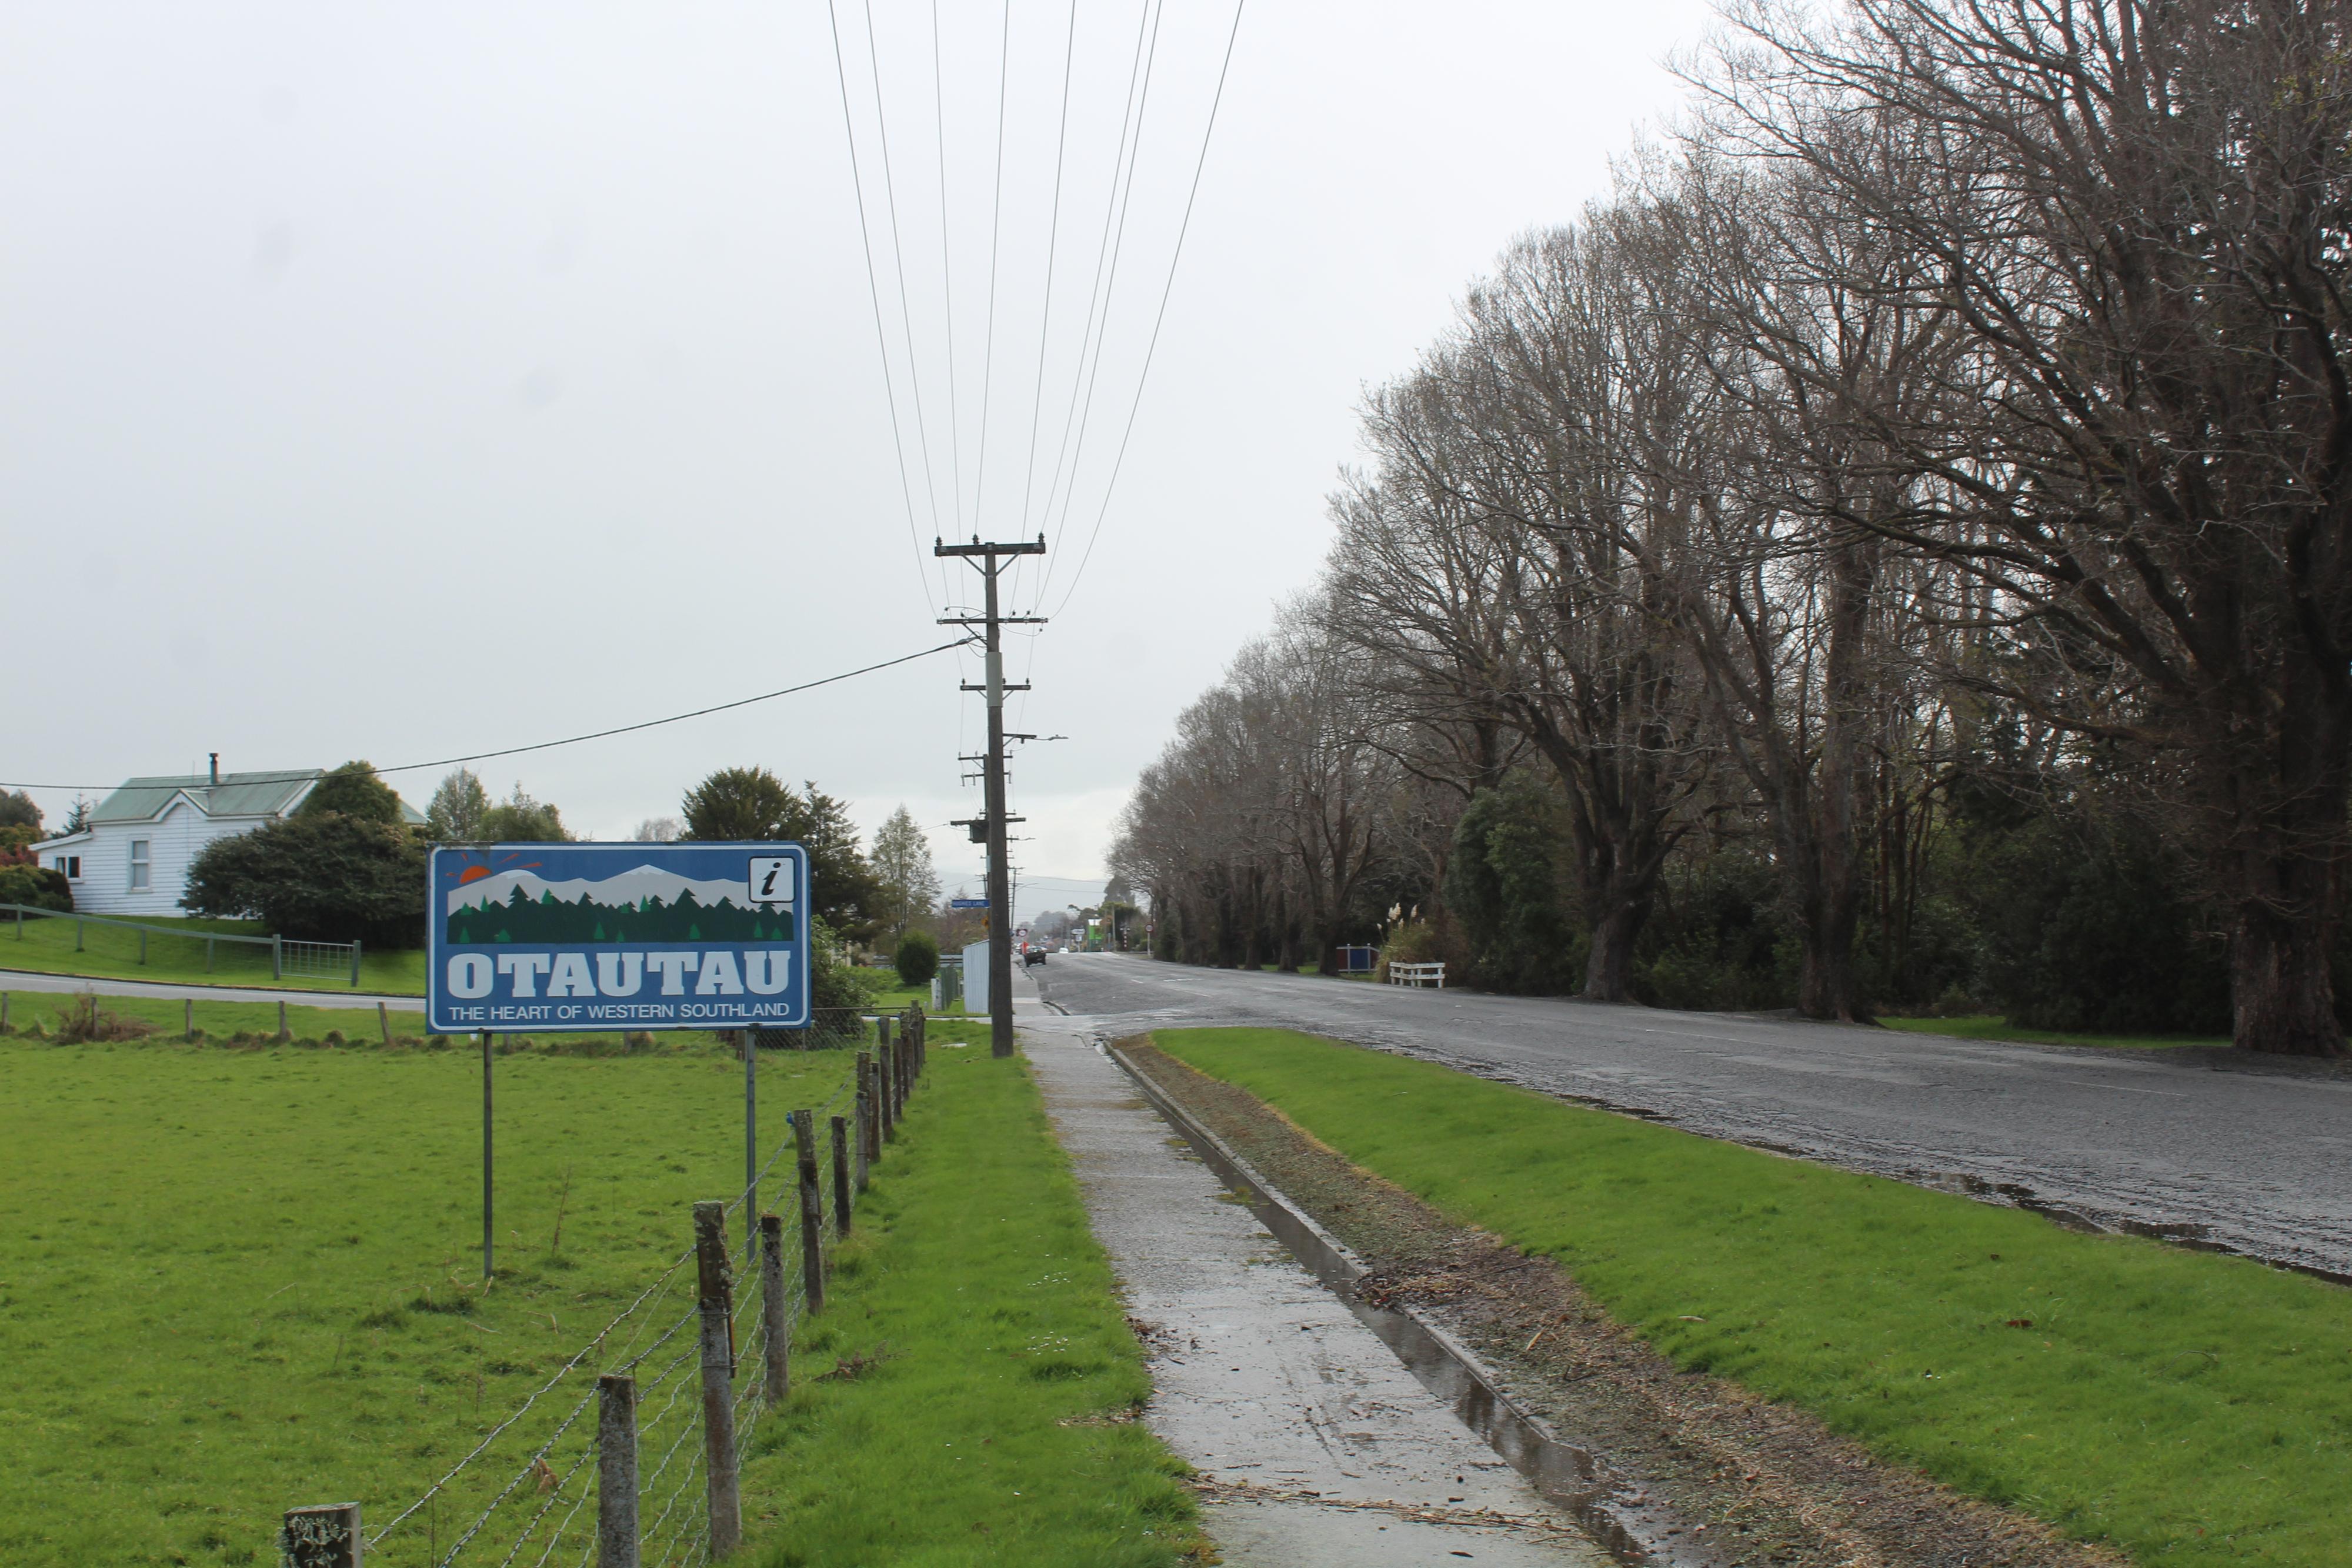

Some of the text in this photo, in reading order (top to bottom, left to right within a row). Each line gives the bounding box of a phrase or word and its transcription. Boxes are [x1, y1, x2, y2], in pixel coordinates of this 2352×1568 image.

[447, 950, 790, 999] OTAUTAU
[448, 1003, 790, 1020] THE HEART OF WESTERN SOUTHLAND
